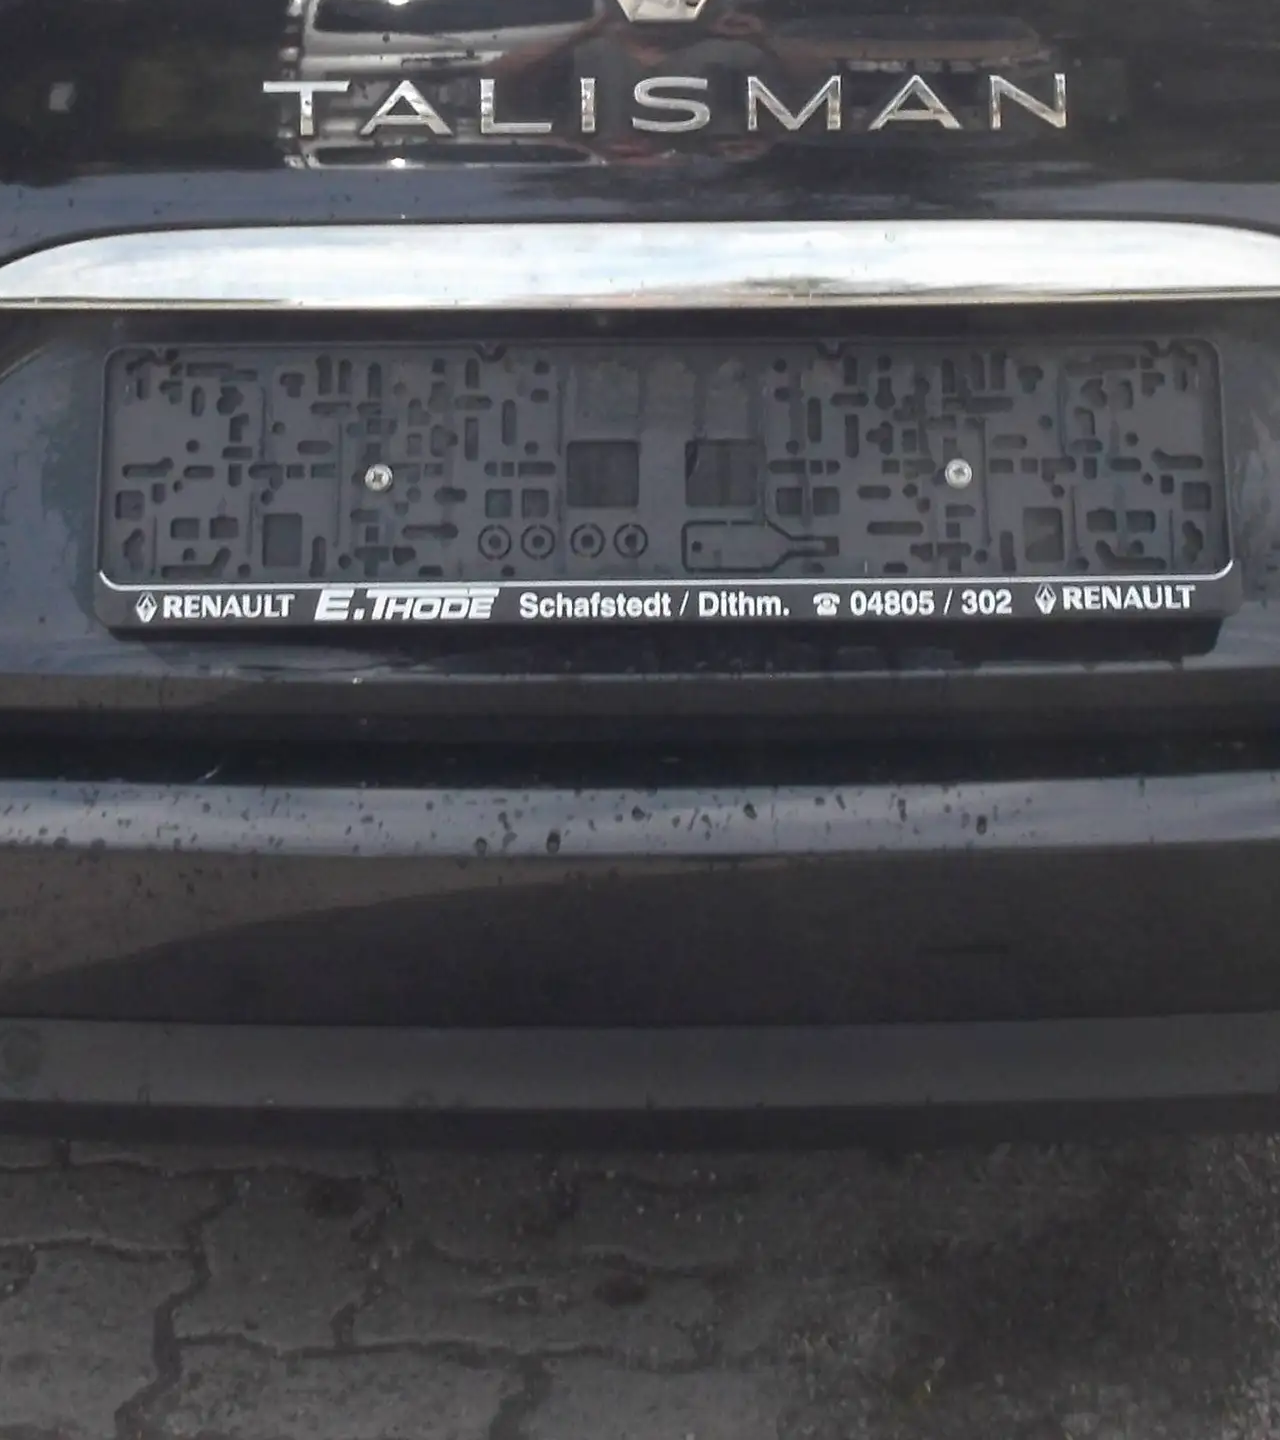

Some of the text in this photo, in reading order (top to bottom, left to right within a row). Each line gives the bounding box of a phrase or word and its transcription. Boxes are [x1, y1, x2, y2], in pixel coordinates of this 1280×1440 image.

[261, 73, 1067, 137] TALISMAN
[162, 593, 296, 619] RENAULT
[519, 591, 672, 619] Schafstedt
[698, 590, 790, 618] Dithm.
[849, 589, 937, 617] 04805
[961, 588, 1013, 616] 302
[1061, 584, 1196, 611] RENAULT
